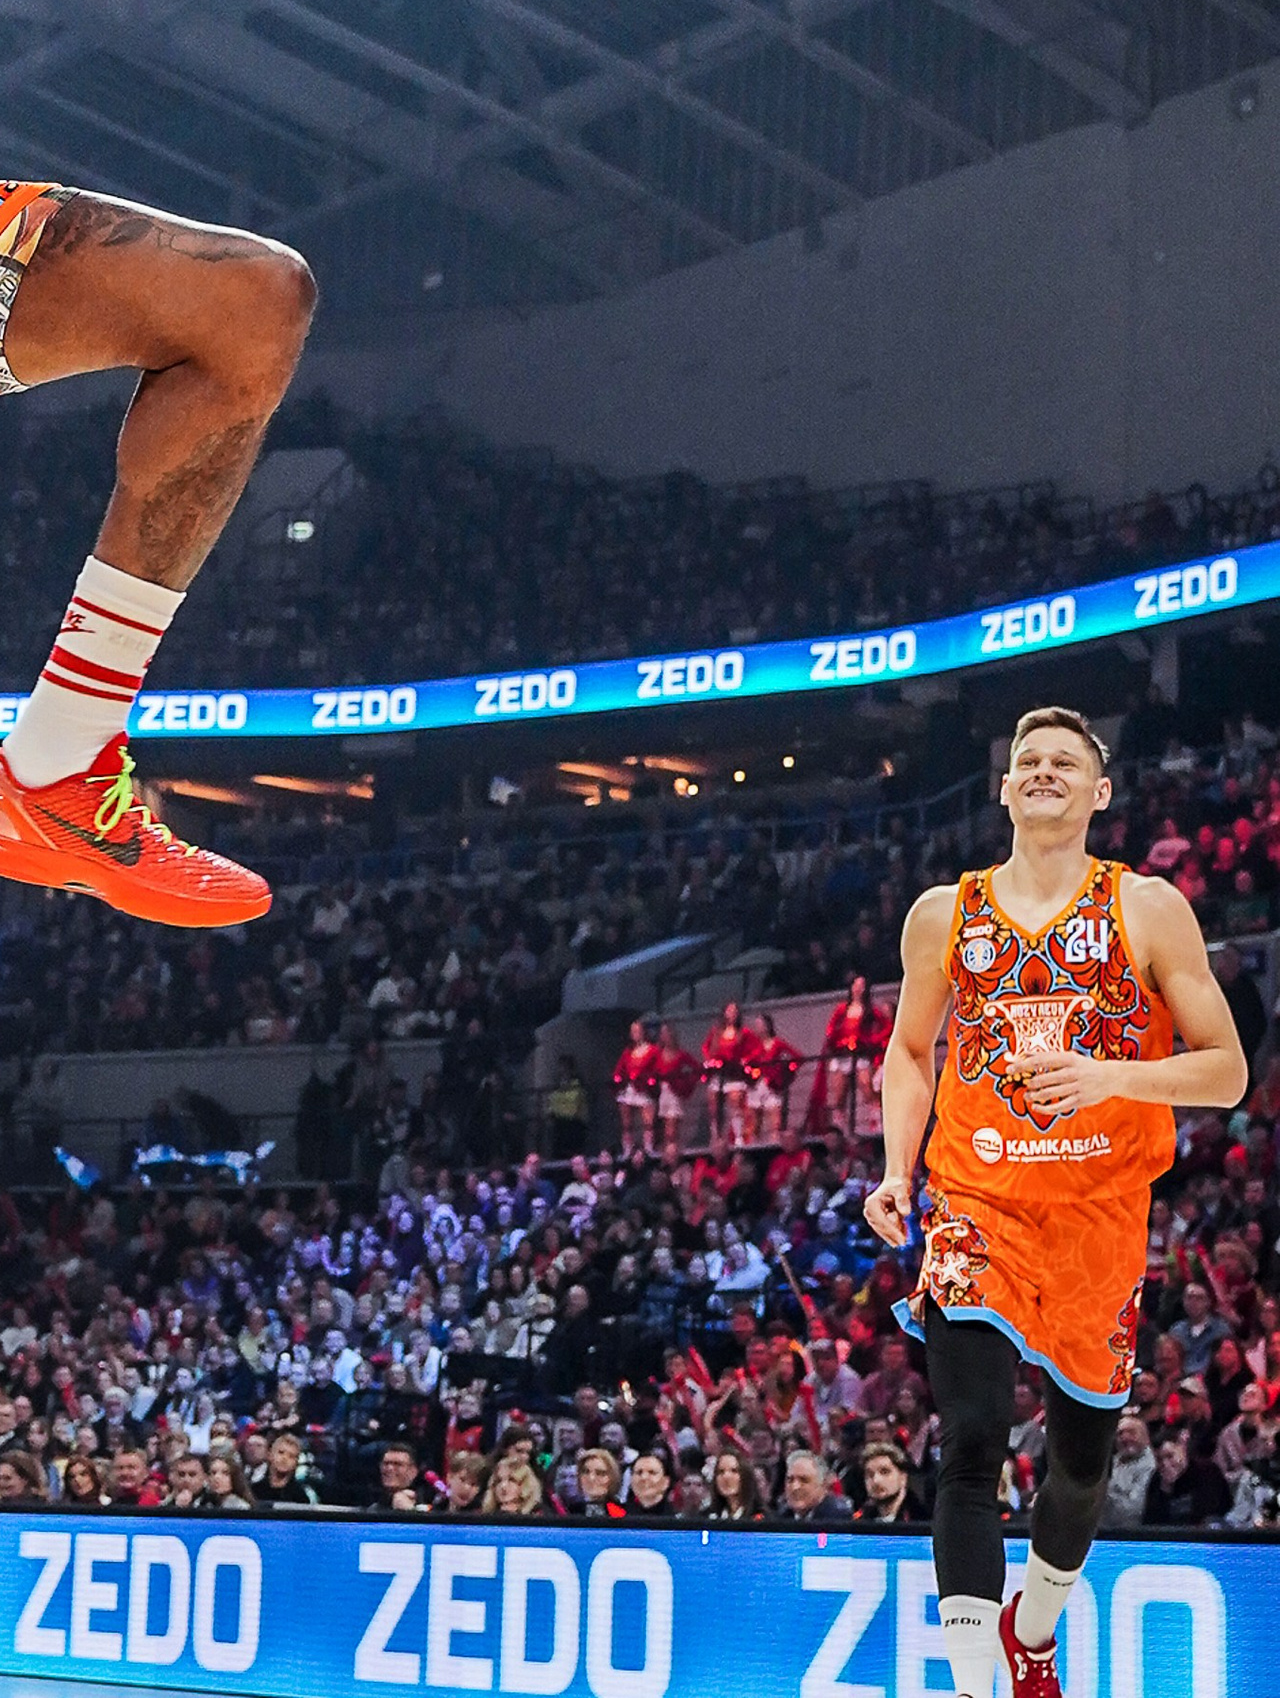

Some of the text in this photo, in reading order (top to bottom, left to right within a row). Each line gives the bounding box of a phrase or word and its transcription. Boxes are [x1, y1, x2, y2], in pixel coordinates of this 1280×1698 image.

[1134, 558, 1238, 620] ZEDO
[981, 595, 1076, 654] ZEDO
[636, 651, 744, 700] ZEDO
[810, 629, 917, 681] ZEDO
[137, 693, 247, 730] ZEDO
[312, 687, 417, 729] ZEDO
[474, 671, 577, 716] ZEDO
[1065, 918, 1108, 963] 24
[1006, 1133, 1110, 1156] КАМКАБЕЛЬ
[14, 1530, 262, 1674] ZEDO
[353, 1541, 674, 1698] ZEDO
[944, 1617, 982, 1627] ZEDO
